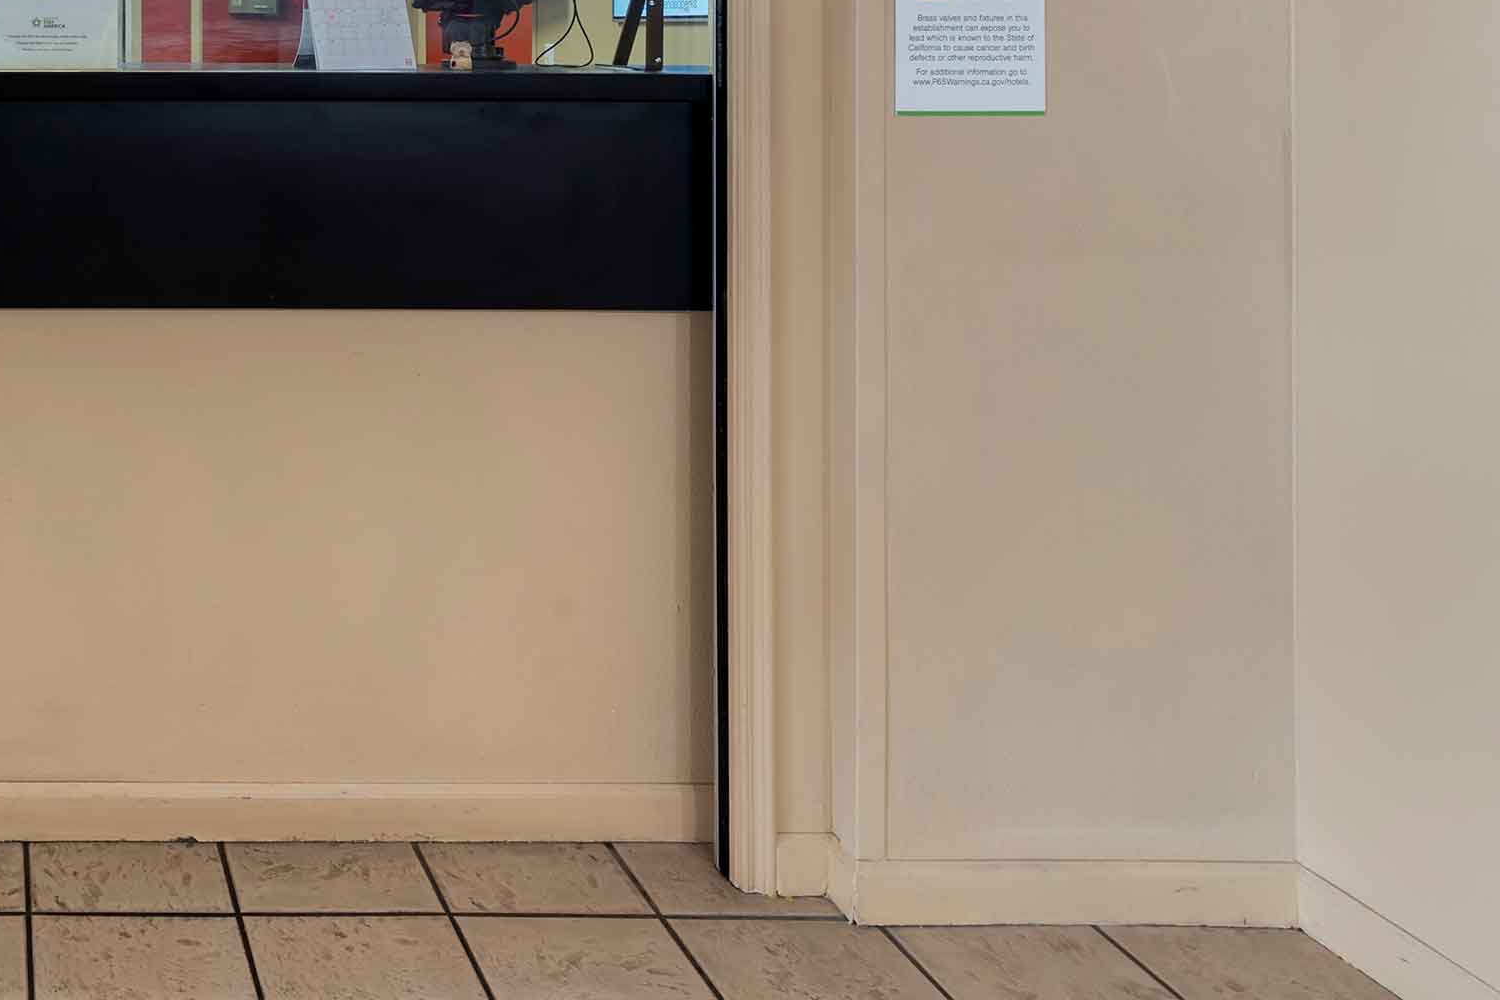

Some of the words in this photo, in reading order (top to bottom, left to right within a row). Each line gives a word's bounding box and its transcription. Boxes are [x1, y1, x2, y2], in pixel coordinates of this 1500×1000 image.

[913, 24, 962, 32] establishment
[965, 24, 978, 32] can
[980, 25, 1006, 33] expose
[1008, 25, 1021, 33] you
[1022, 24, 1030, 32] to
[909, 34, 924, 42] lead
[926, 34, 948, 42] which
[950, 34, 956, 42] is
[958, 34, 981, 42] known
[983, 34, 991, 42] to
[992, 34, 1005, 42] the
[1007, 34, 1026, 42] State
[1027, 34, 1034, 42] of
[908, 44, 942, 52] California
[943, 44, 951, 52] to
[953, 44, 974, 52] cause
[976, 44, 1001, 52] cancer
[1003, 44, 1017, 52] and
[1018, 44, 1035, 52] birth
[909, 54, 936, 62] defects
[938, 54, 946, 62] or
[947, 54, 966, 62] other
[968, 54, 1012, 62] reproductive
[1008, 69, 1018, 77] go
